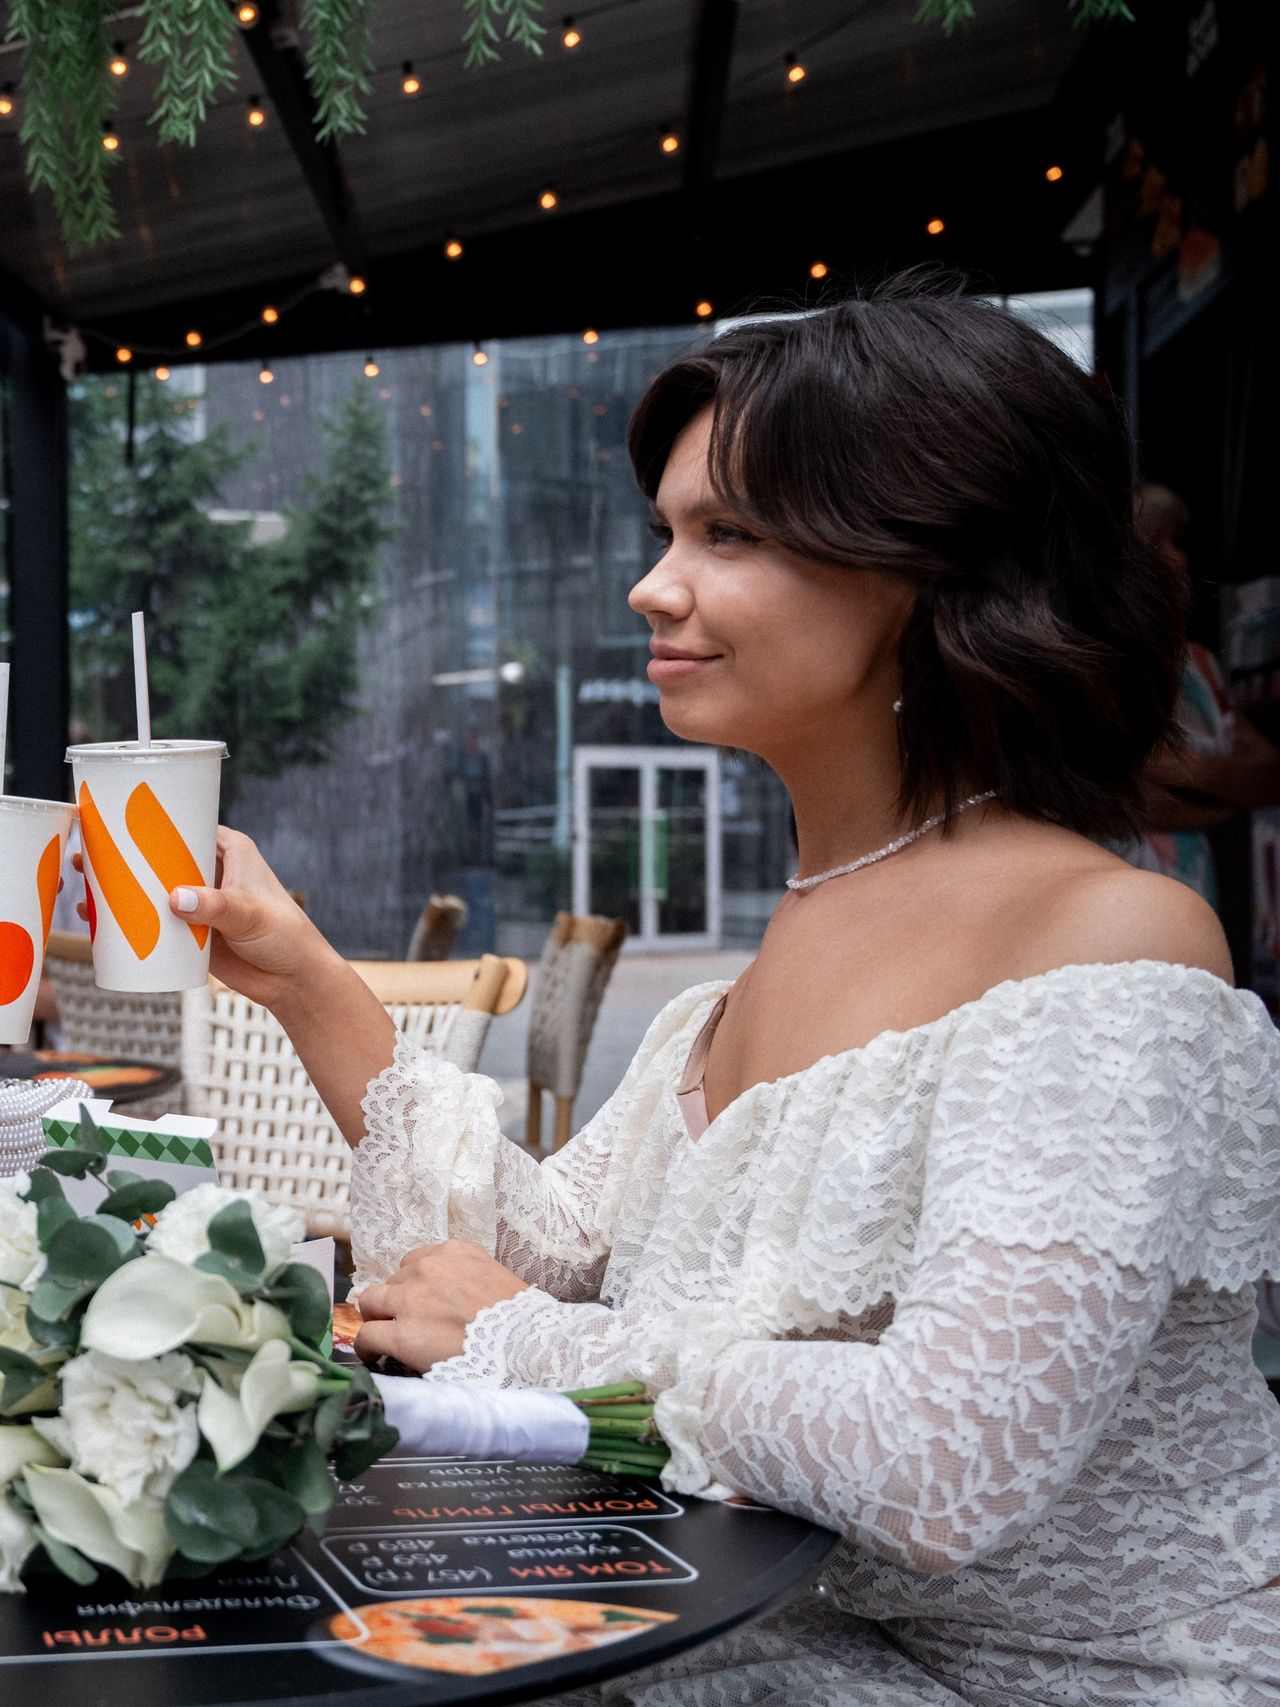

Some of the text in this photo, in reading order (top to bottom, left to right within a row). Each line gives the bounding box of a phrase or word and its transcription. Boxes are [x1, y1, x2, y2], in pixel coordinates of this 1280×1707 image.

[429, 1464, 511, 1478] угорь
[397, 1476, 524, 1490] креветка
[470, 1488, 539, 1502] краб
[392, 1498, 659, 1520] РОЛЛЫ ГРИЛЬ
[378, 1538, 436, 1552] 489
[462, 1530, 603, 1547] креветка
[507, 1543, 622, 1560] курица
[393, 1553, 448, 1567] 459
[576, 1559, 672, 1577] ТОМ
[509, 1564, 574, 1580] ЯМ
[76, 1594, 321, 1619] Филадельфия
[42, 1623, 208, 1648] РОЛЛЫ
